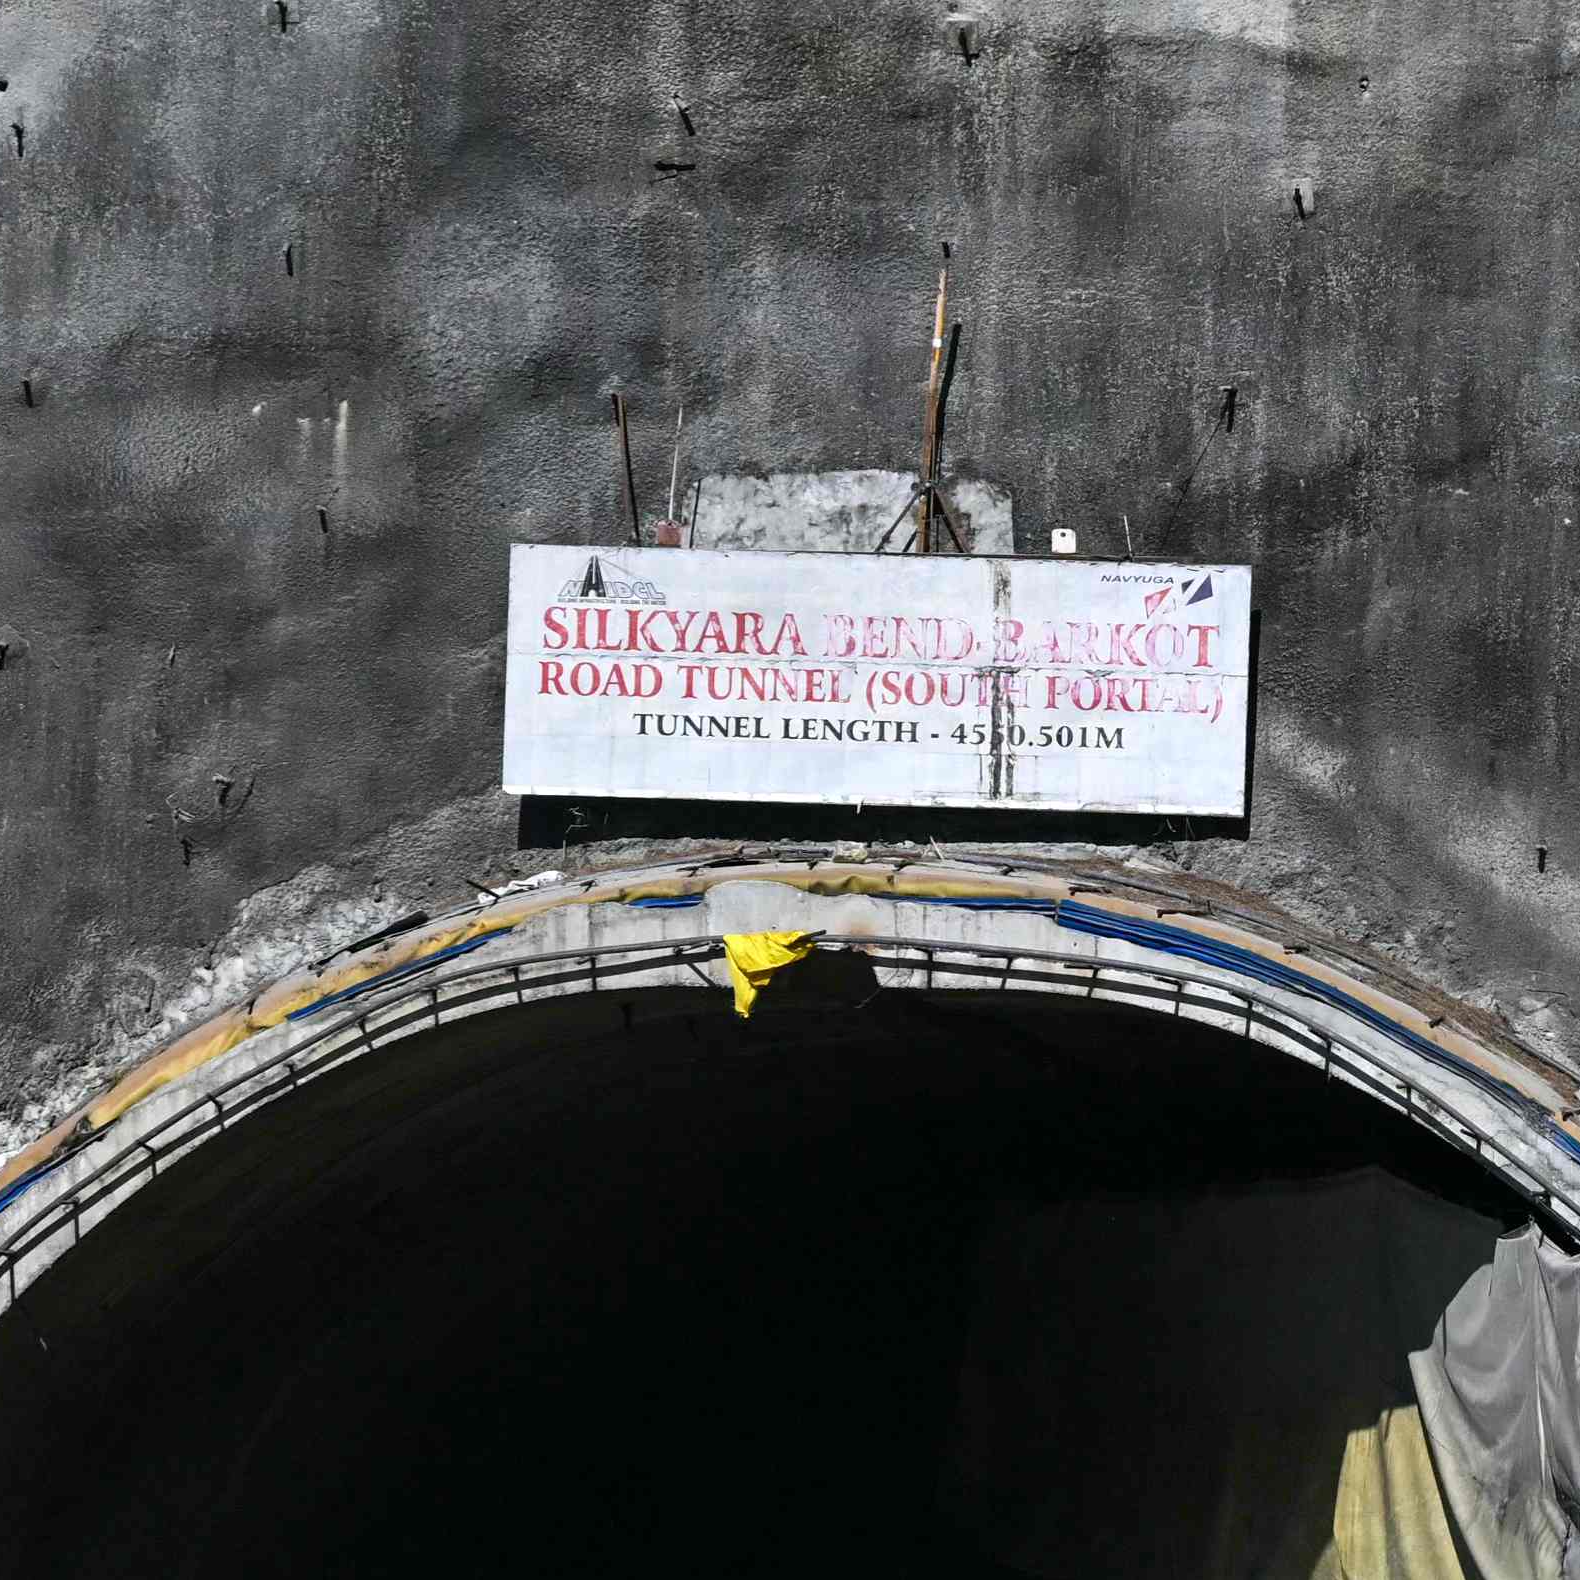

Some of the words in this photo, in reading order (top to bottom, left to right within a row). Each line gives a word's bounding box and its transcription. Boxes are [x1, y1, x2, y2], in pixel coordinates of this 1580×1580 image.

[1100, 574, 1175, 585] NAVYUGA
[542, 606, 809, 657] SILKYARA
[538, 661, 663, 698] ROAD
[677, 665, 852, 703] TUNNEL
[866, 669, 1030, 713] (SOUTH
[1044, 674, 1224, 724] PORTAL)
[633, 713, 771, 739] TUNNEL
[782, 717, 920, 743] LENGTH
[950, 723, 1125, 750] 4550.501M
